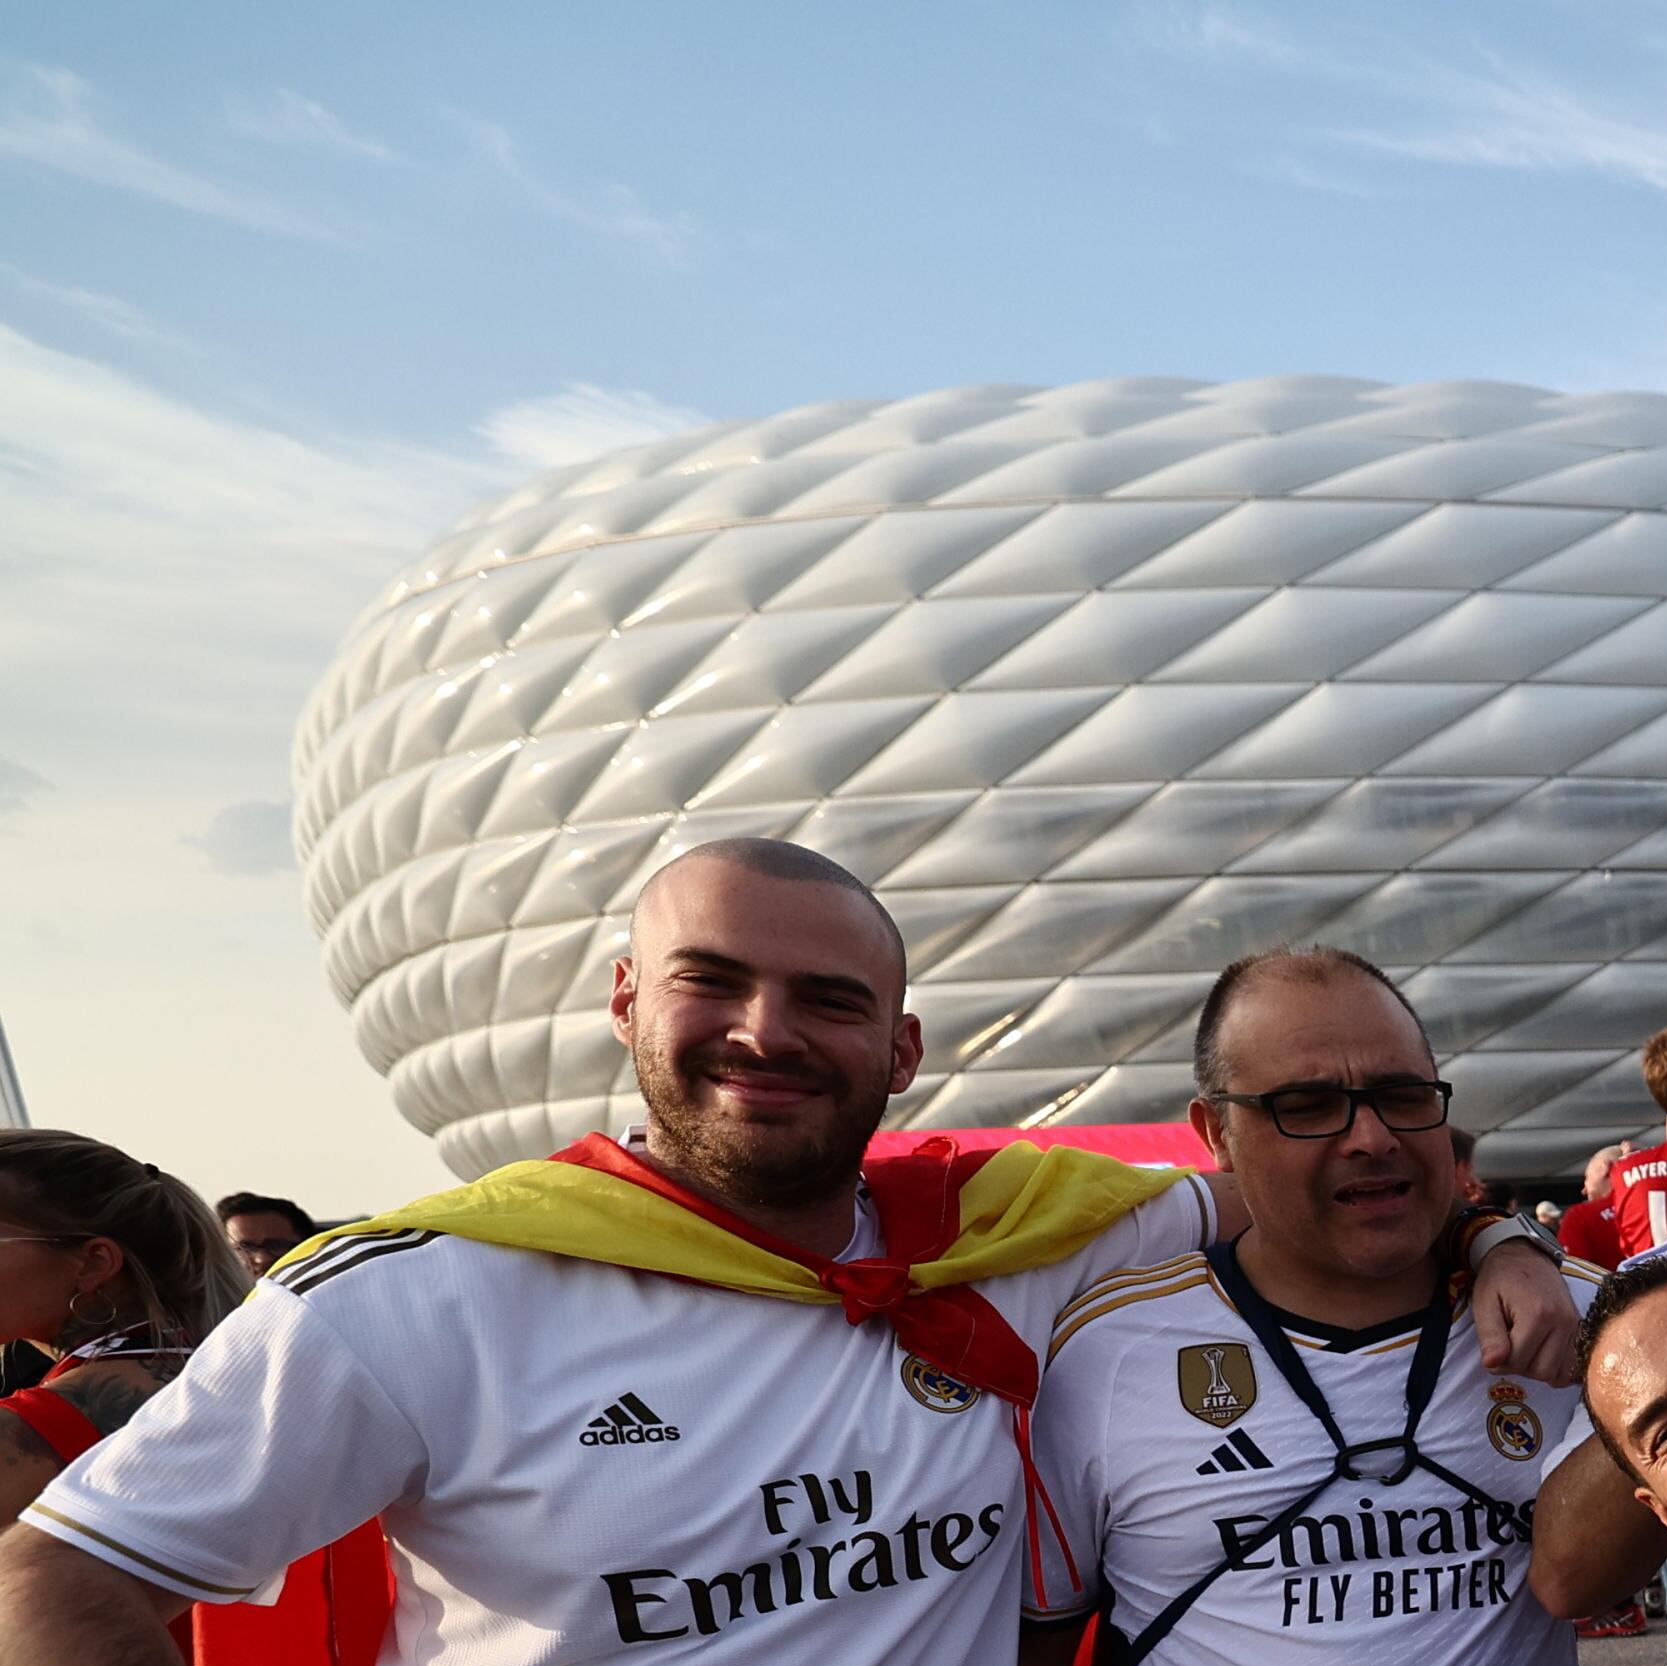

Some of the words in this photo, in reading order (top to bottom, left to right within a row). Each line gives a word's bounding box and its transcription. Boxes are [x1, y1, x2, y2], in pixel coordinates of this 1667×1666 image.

[579, 1422, 681, 1446] adidas
[1202, 1395, 1238, 1408] FIFA
[1212, 1411, 1232, 1419] 2022
[760, 1470, 872, 1535] Fly
[1213, 1498, 1535, 1571] Emirates
[599, 1503, 1004, 1643] Emirates
[1282, 1574, 1352, 1627] FLY
[1373, 1558, 1511, 1618] BETTER
